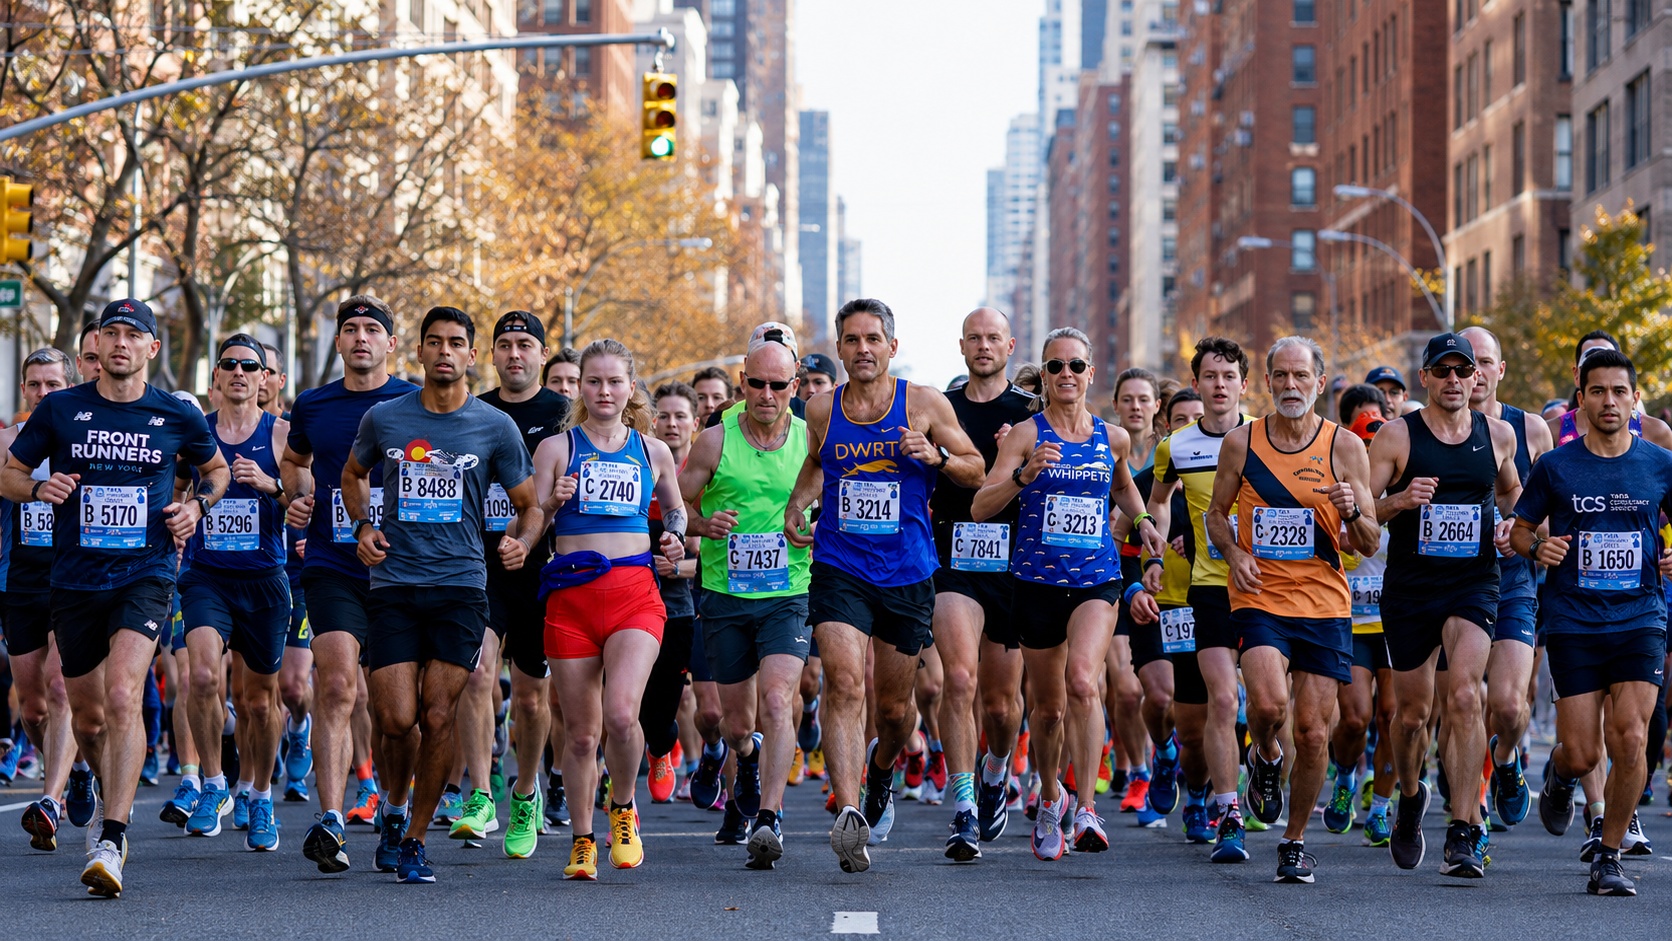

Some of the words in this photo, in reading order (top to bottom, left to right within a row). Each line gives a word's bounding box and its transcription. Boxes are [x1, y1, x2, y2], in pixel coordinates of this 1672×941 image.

[87, 430, 150, 448] FRONT
[71, 444, 163, 464] RUNNERS
[835, 441, 899, 460] DWRT
[90, 463, 113, 471] NEW
[1048, 468, 1111, 483] WHIPPETS
[402, 477, 412, 492] B
[417, 477, 457, 498] 8488
[585, 478, 595, 494] C
[599, 479, 635, 502] 2740
[842, 497, 850, 512] B
[856, 499, 891, 520] 3214
[1571, 494, 1606, 513] tcs
[24, 512, 32, 528] B
[84, 504, 94, 523] B
[101, 505, 137, 526] 5170
[206, 515, 213, 531] B
[218, 515, 252, 533] 5296
[336, 506, 344, 523] B
[1047, 512, 1056, 527] C
[1062, 514, 1096, 536] 3213
[1255, 524, 1263, 539] C
[1270, 525, 1307, 546] 2328
[1424, 521, 1432, 537] B
[1438, 521, 1473, 542] 2664
[955, 538, 963, 552] C
[970, 539, 1001, 559] 7841
[730, 550, 739, 565] C
[745, 549, 780, 569] 7437
[1582, 549, 1592, 567] B
[1598, 549, 1634, 572] 1650
[1353, 591, 1360, 601] C
[1165, 625, 1173, 637] C
